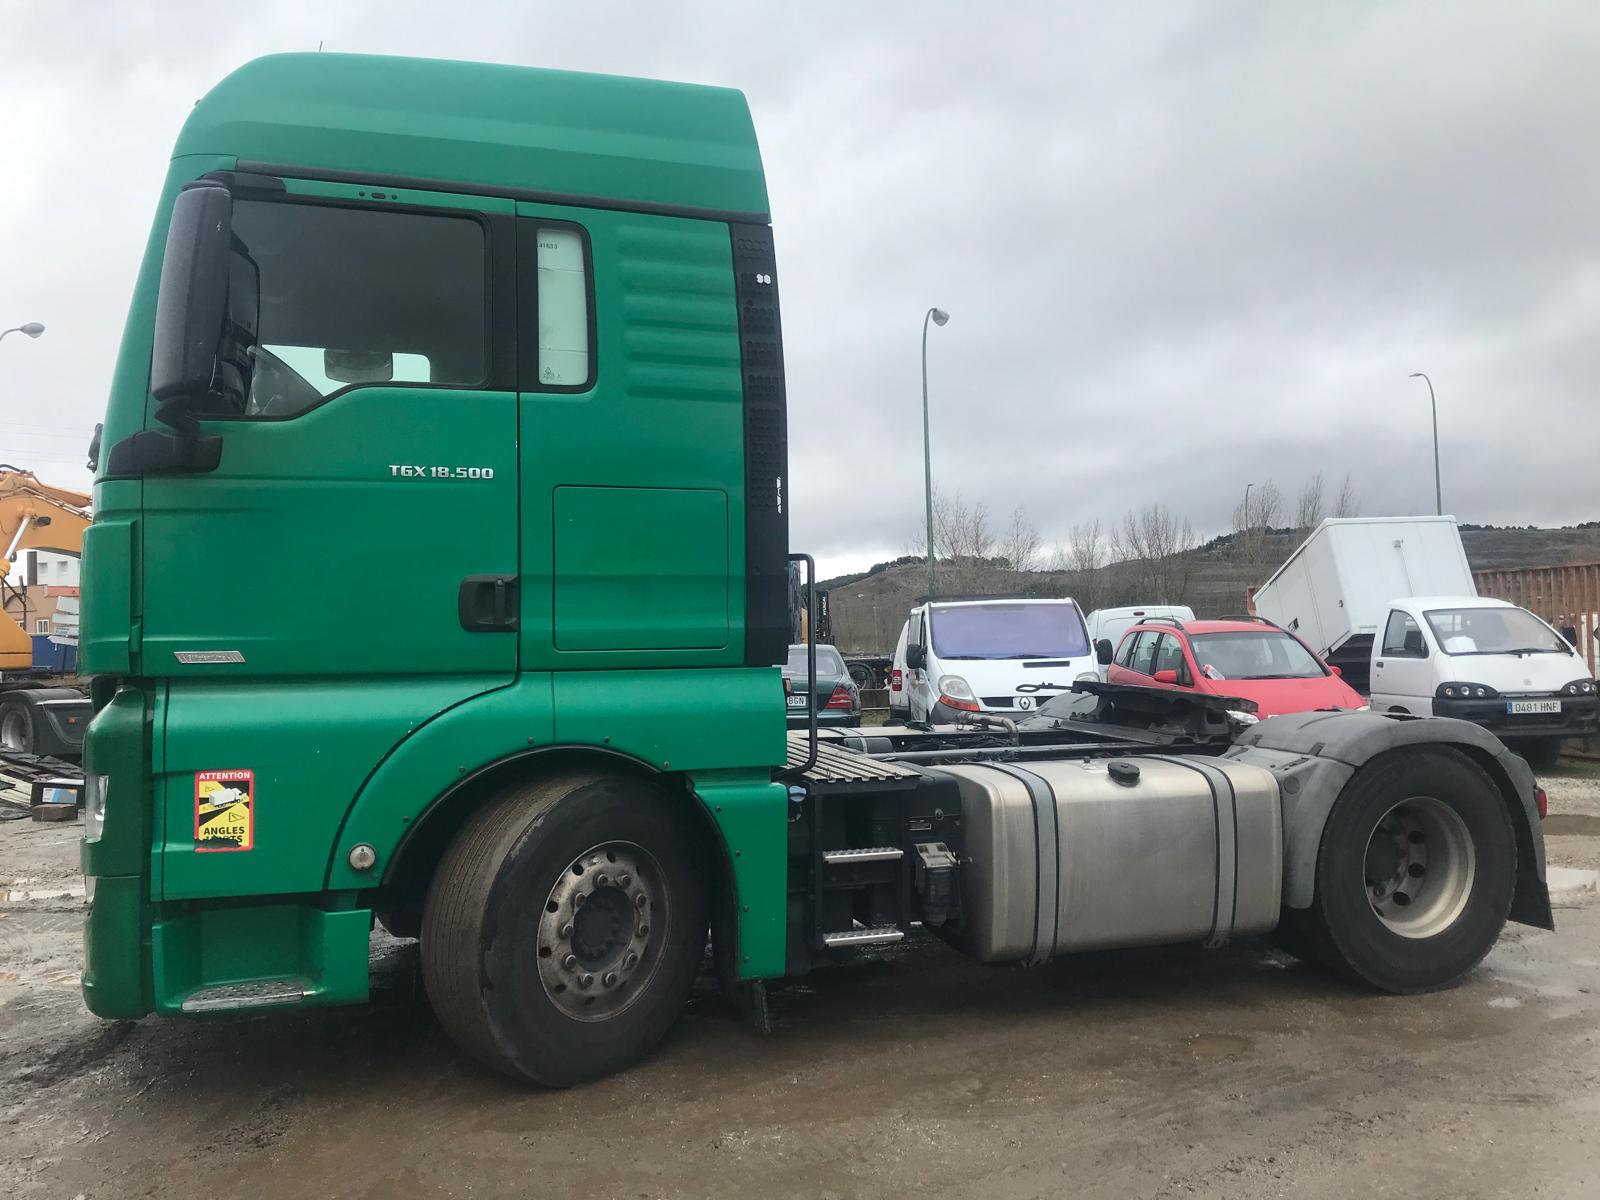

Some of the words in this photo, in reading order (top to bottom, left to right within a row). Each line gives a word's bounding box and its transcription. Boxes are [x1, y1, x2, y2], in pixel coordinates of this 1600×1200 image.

[388, 465, 426, 477] TGX
[430, 466, 494, 479] 18.500
[788, 697, 805, 705] BGN
[1515, 703, 1537, 712] 0481
[1540, 702, 1558, 712] HNF
[199, 772, 251, 780] ATTENTION
[203, 826, 245, 835] ANGLES
